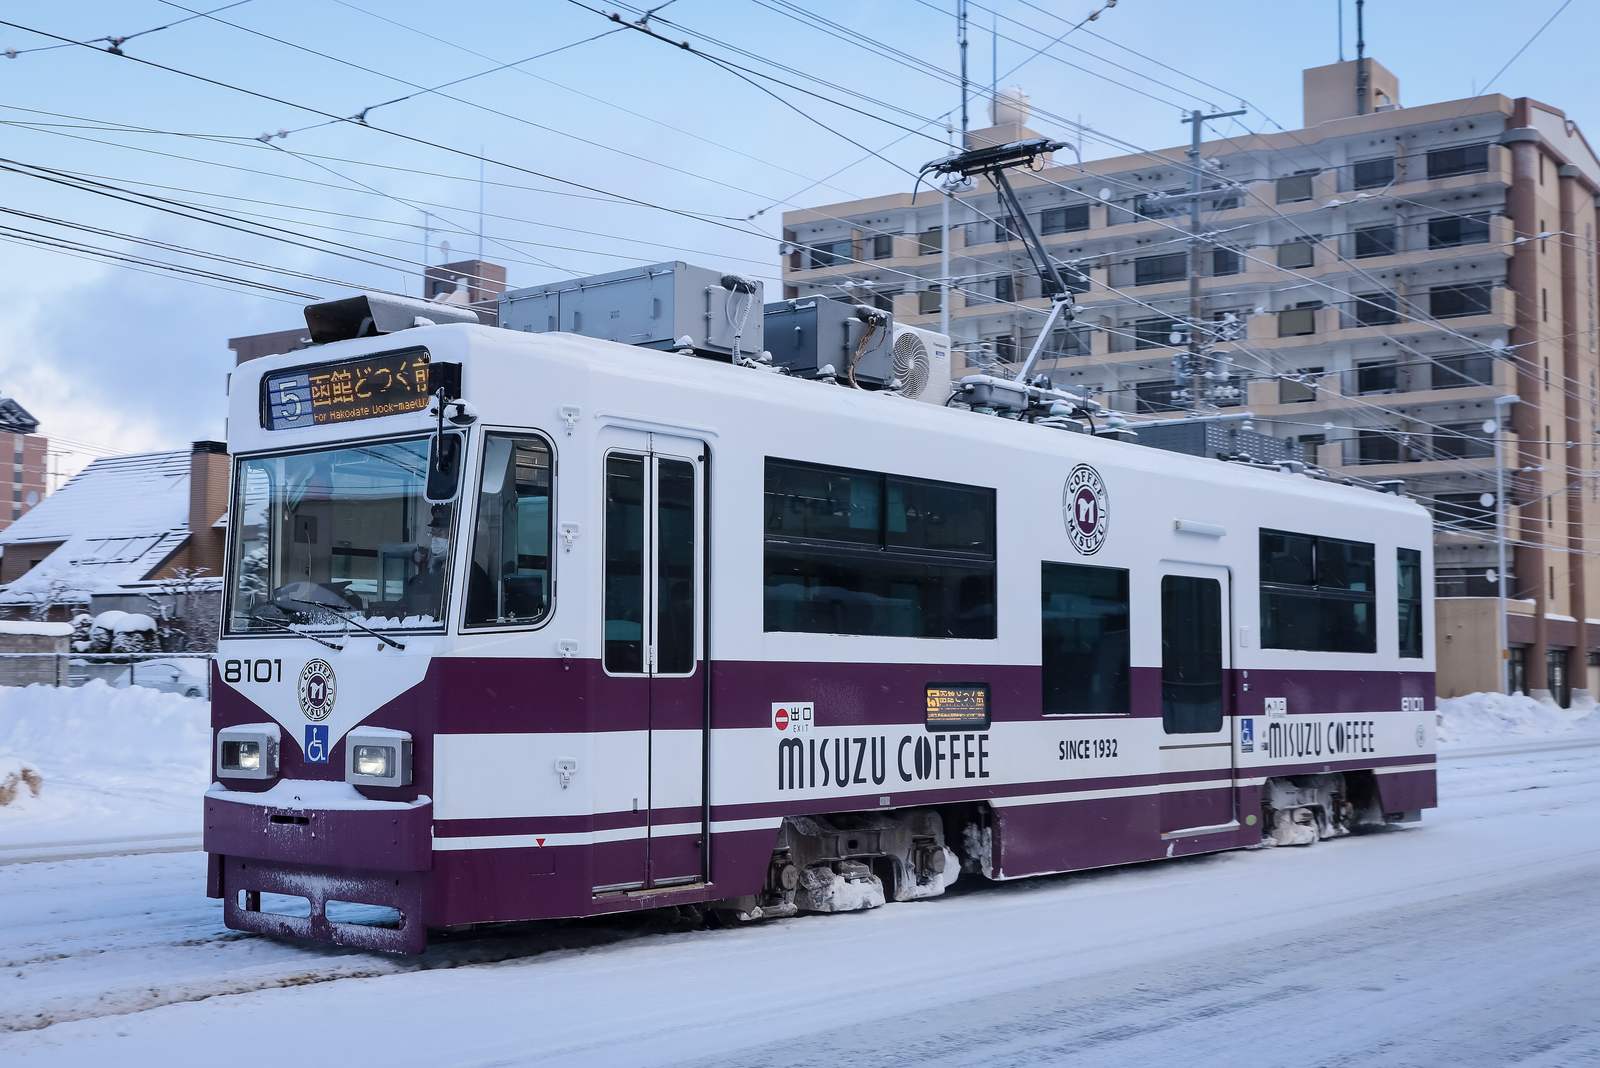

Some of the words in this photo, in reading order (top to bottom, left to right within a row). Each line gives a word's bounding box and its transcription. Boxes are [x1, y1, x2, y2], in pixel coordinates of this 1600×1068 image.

[1069, 471, 1103, 500] COFFEE
[224, 658, 282, 683] 8101
[303, 663, 331, 682] COFFEE
[791, 706, 811, 721] 出口
[793, 723, 809, 733] EXIT
[1269, 722, 1322, 758] MISUZU
[1327, 721, 1374, 754] COFFEE
[1059, 739, 1090, 761] SINCE
[1093, 738, 1118, 758] 1932
[778, 736, 886, 790] MISUZU
[897, 734, 990, 782] COFFEE
